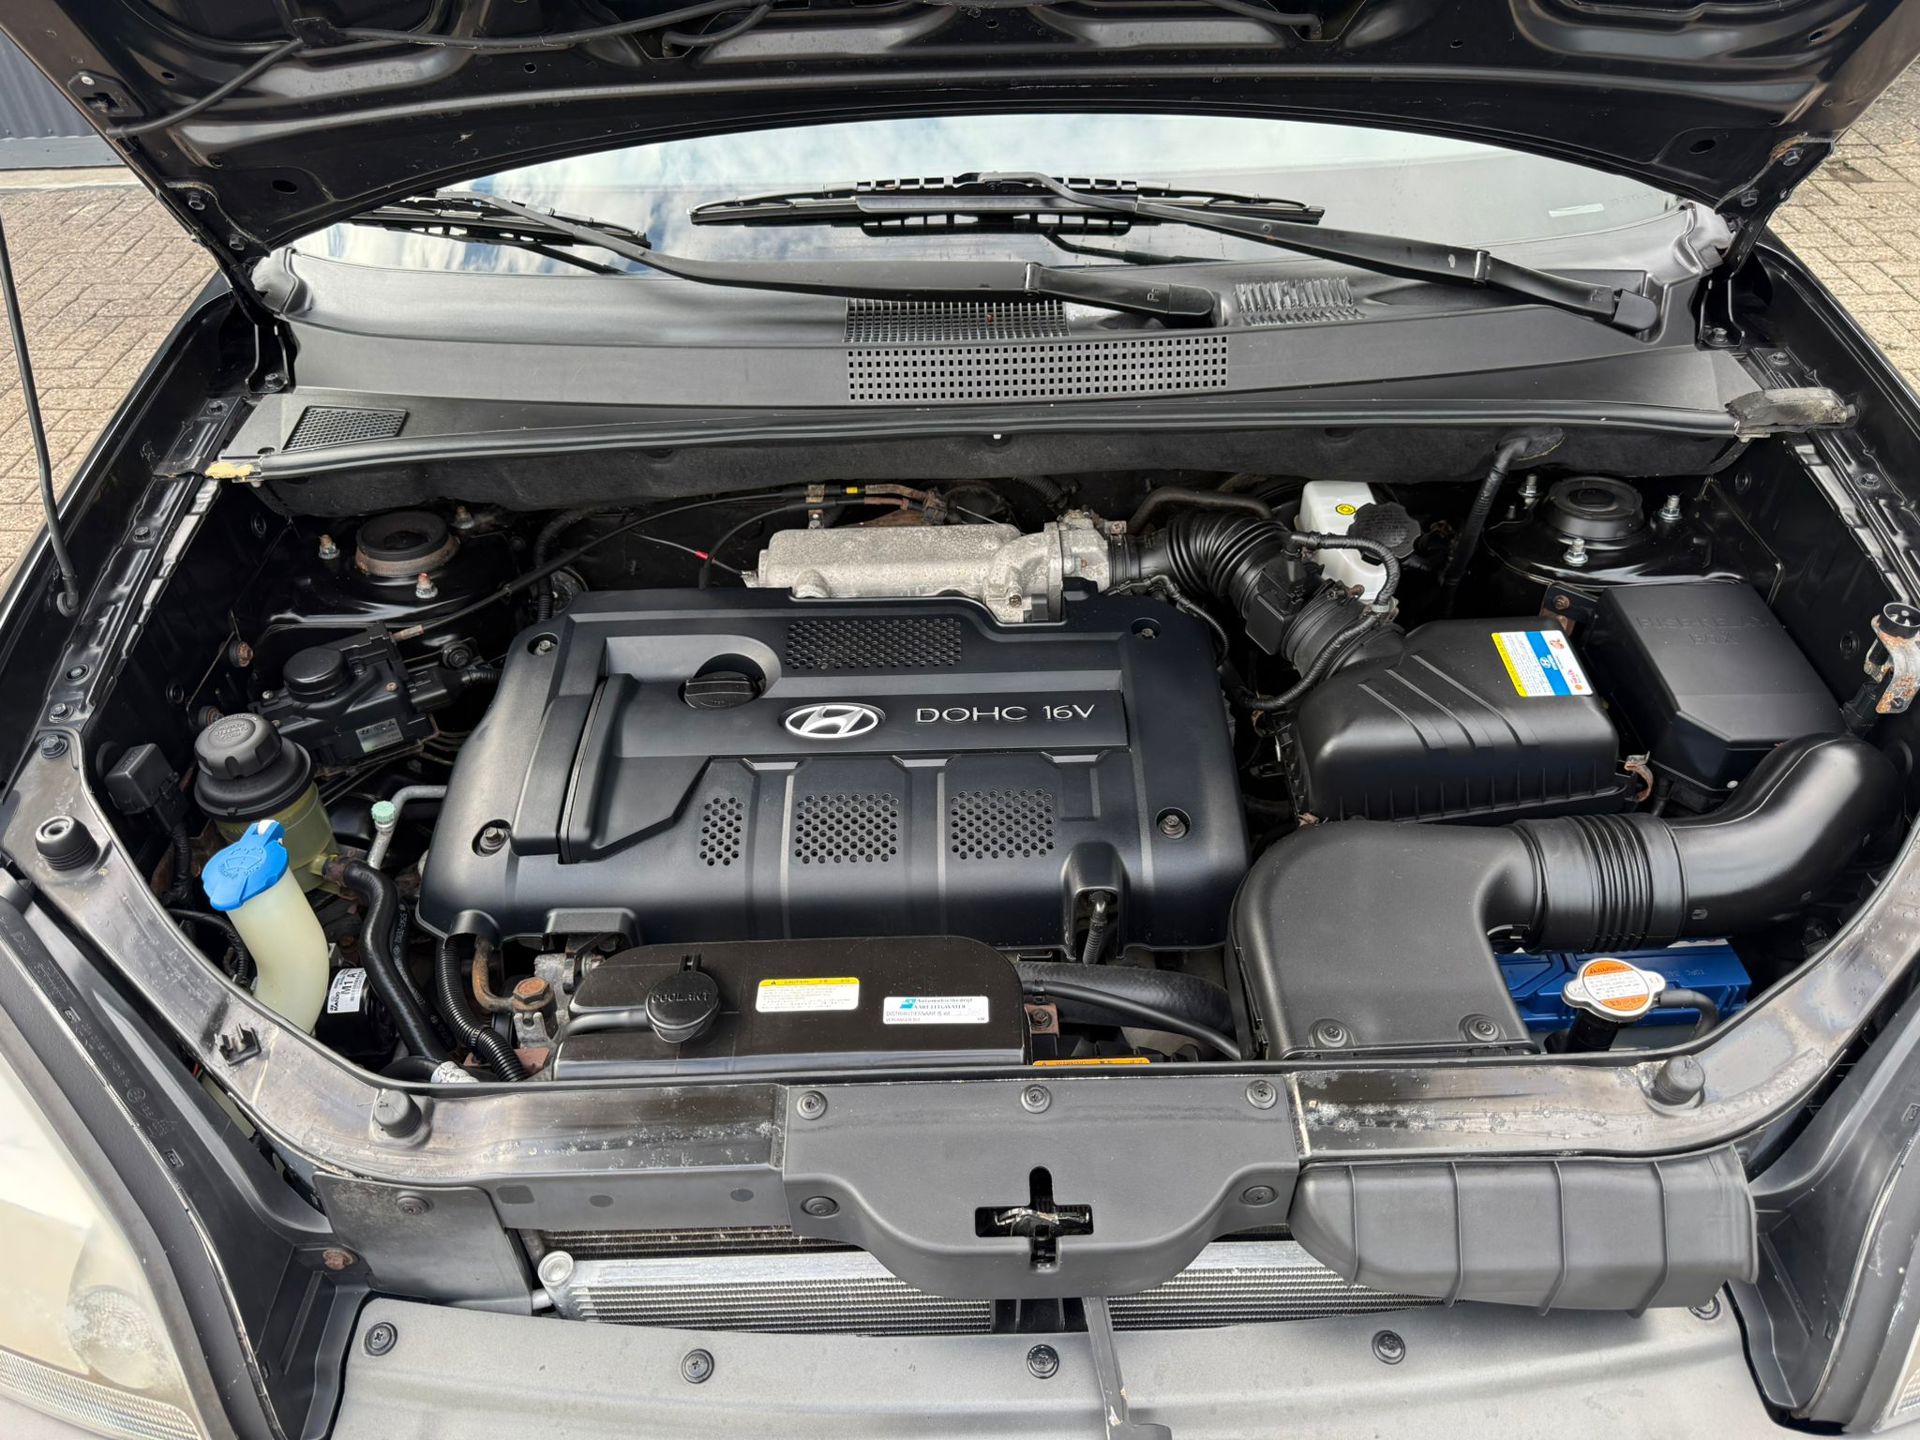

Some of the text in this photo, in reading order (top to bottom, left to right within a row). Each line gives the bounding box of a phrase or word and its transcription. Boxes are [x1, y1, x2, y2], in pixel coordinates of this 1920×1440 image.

[916, 704, 1095, 723] DOHC 16V
[651, 992, 710, 1003] COOLANT
